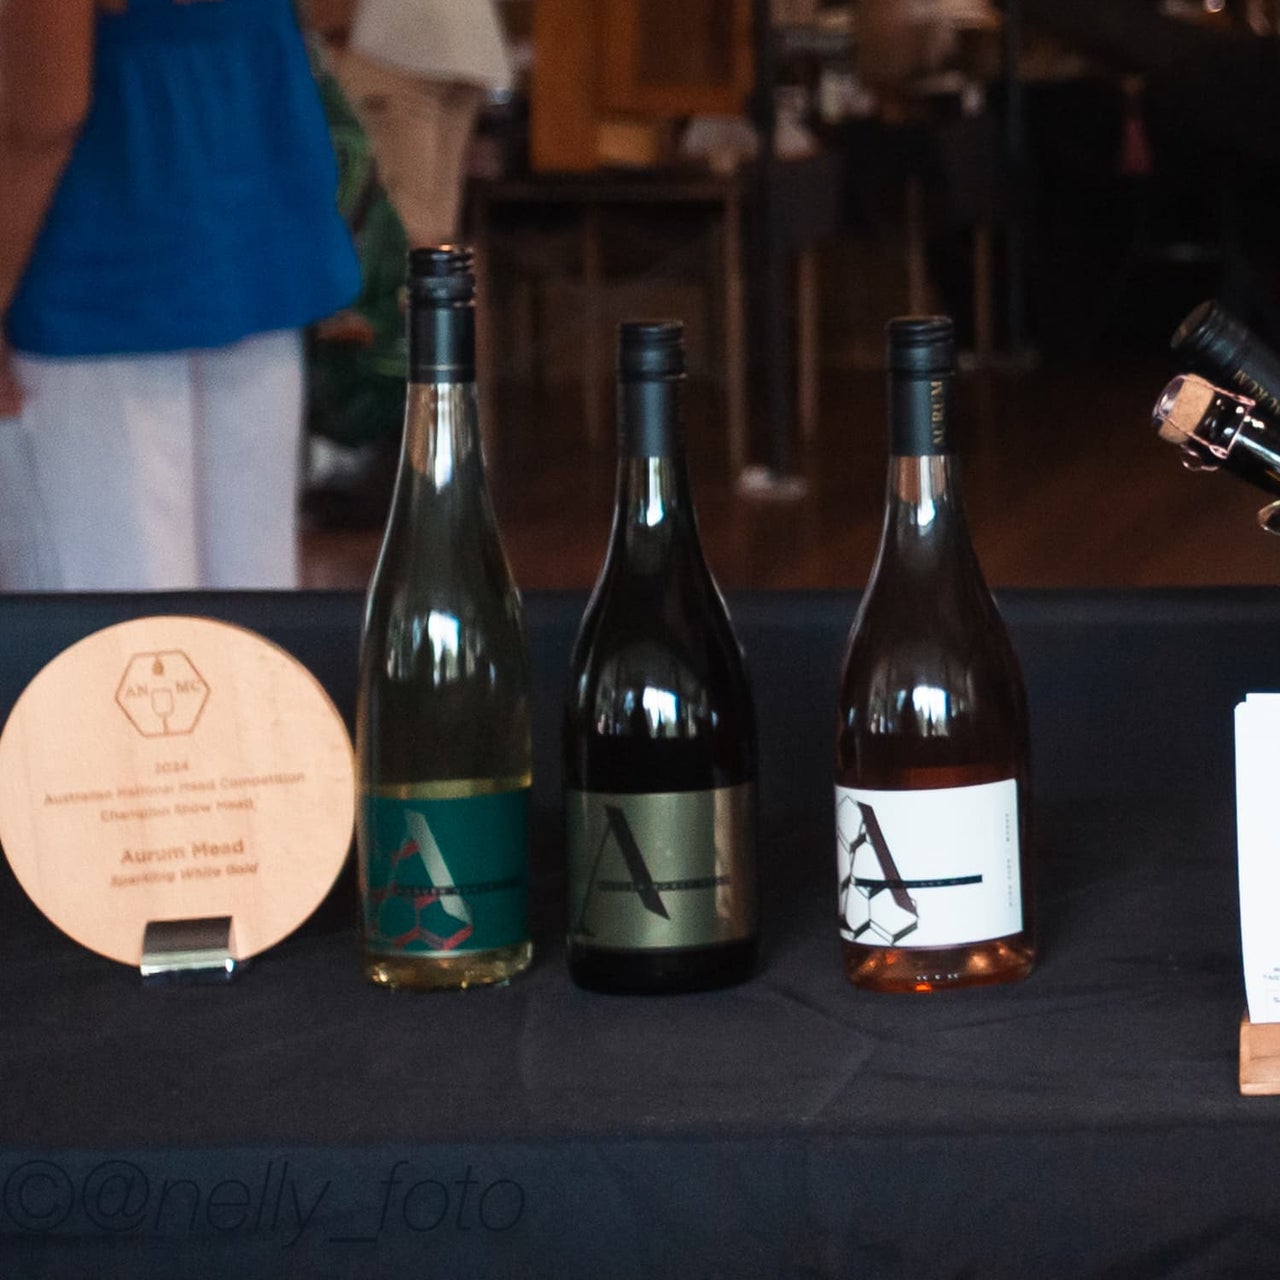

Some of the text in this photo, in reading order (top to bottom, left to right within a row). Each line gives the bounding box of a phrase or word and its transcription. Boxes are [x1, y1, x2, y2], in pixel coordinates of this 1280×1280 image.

[44, 789, 112, 806] Australian
[220, 771, 306, 790] Competition
[120, 838, 244, 864] Aurum Mead
